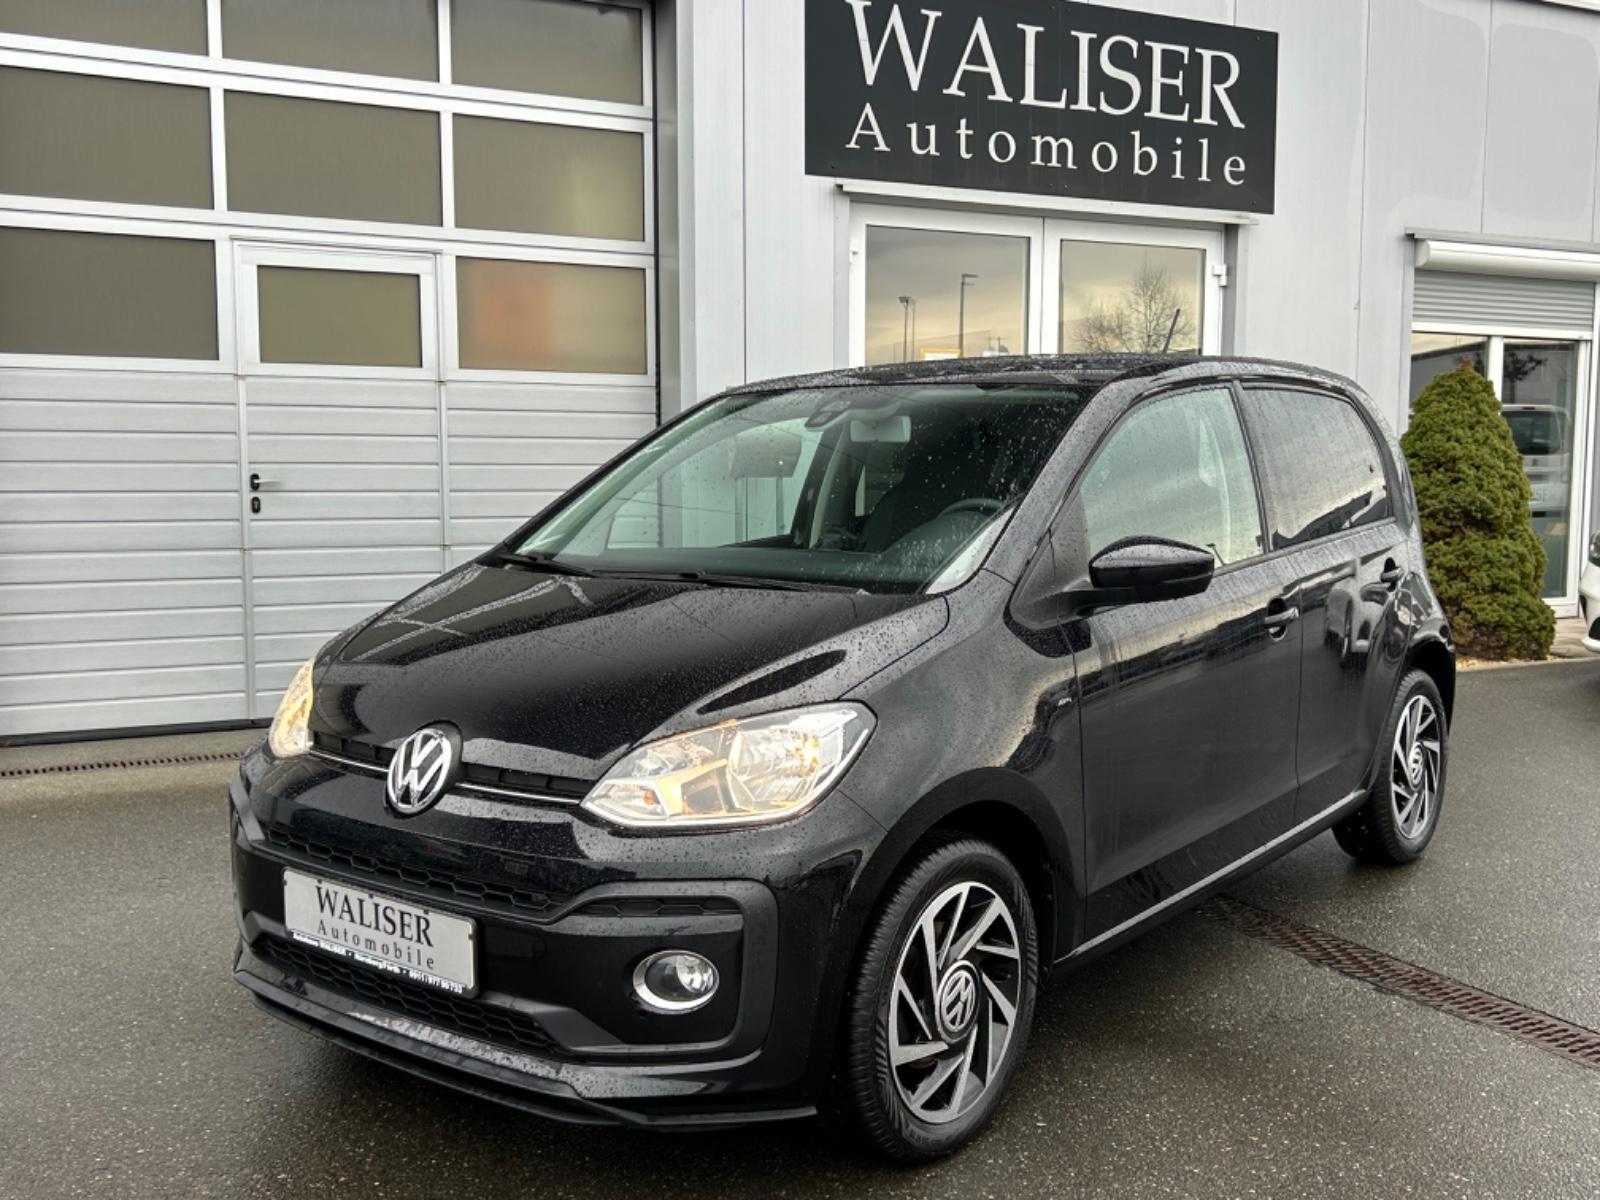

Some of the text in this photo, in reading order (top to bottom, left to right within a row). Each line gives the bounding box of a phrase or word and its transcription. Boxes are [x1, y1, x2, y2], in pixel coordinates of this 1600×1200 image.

[844, 0, 1246, 129] WALISER
[845, 102, 1246, 186] Automobile
[387, 728, 452, 813] VW
[315, 885, 434, 947] WALISER
[316, 919, 435, 970] Automobile
